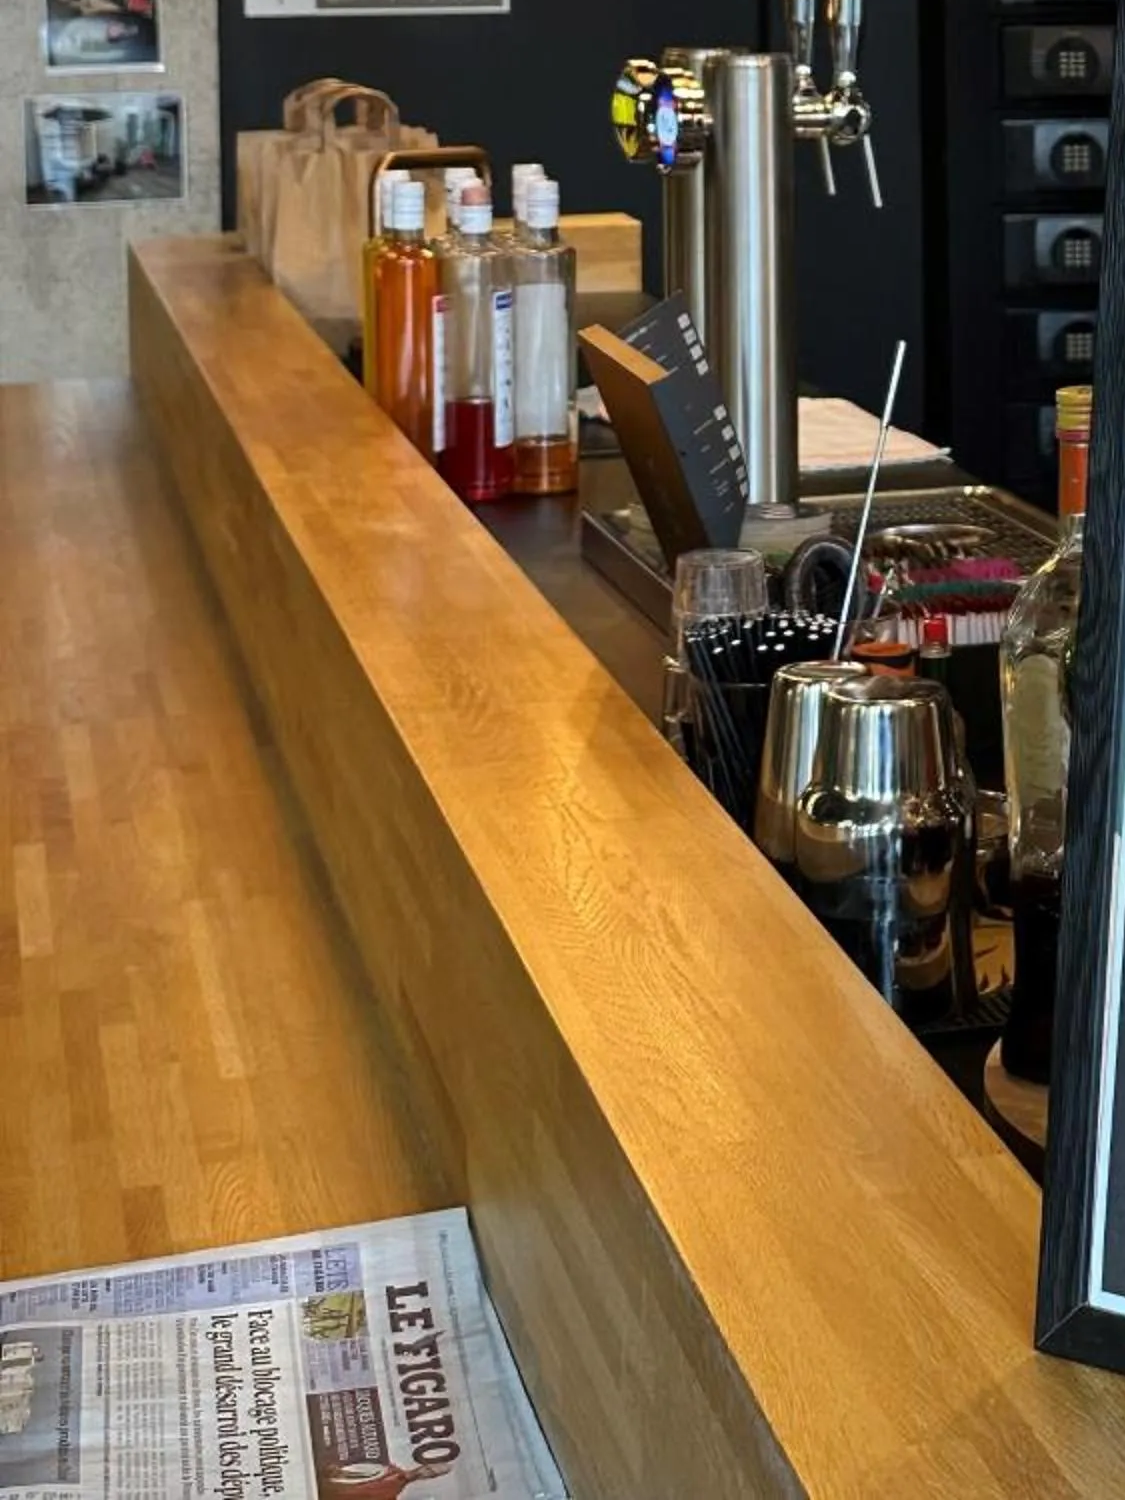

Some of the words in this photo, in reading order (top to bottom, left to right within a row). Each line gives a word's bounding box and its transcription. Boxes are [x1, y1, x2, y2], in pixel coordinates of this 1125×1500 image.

[211, 1312, 239, 1327] le
[248, 1309, 273, 1343] Face
[386, 1281, 434, 1332] LE
[205, 1329, 243, 1371] grand
[251, 1346, 273, 1365] au
[248, 1367, 281, 1425] blocage
[394, 1331, 461, 1465] FIGARO
[219, 1441, 248, 1465] des
[250, 1428, 289, 1497] politique,
